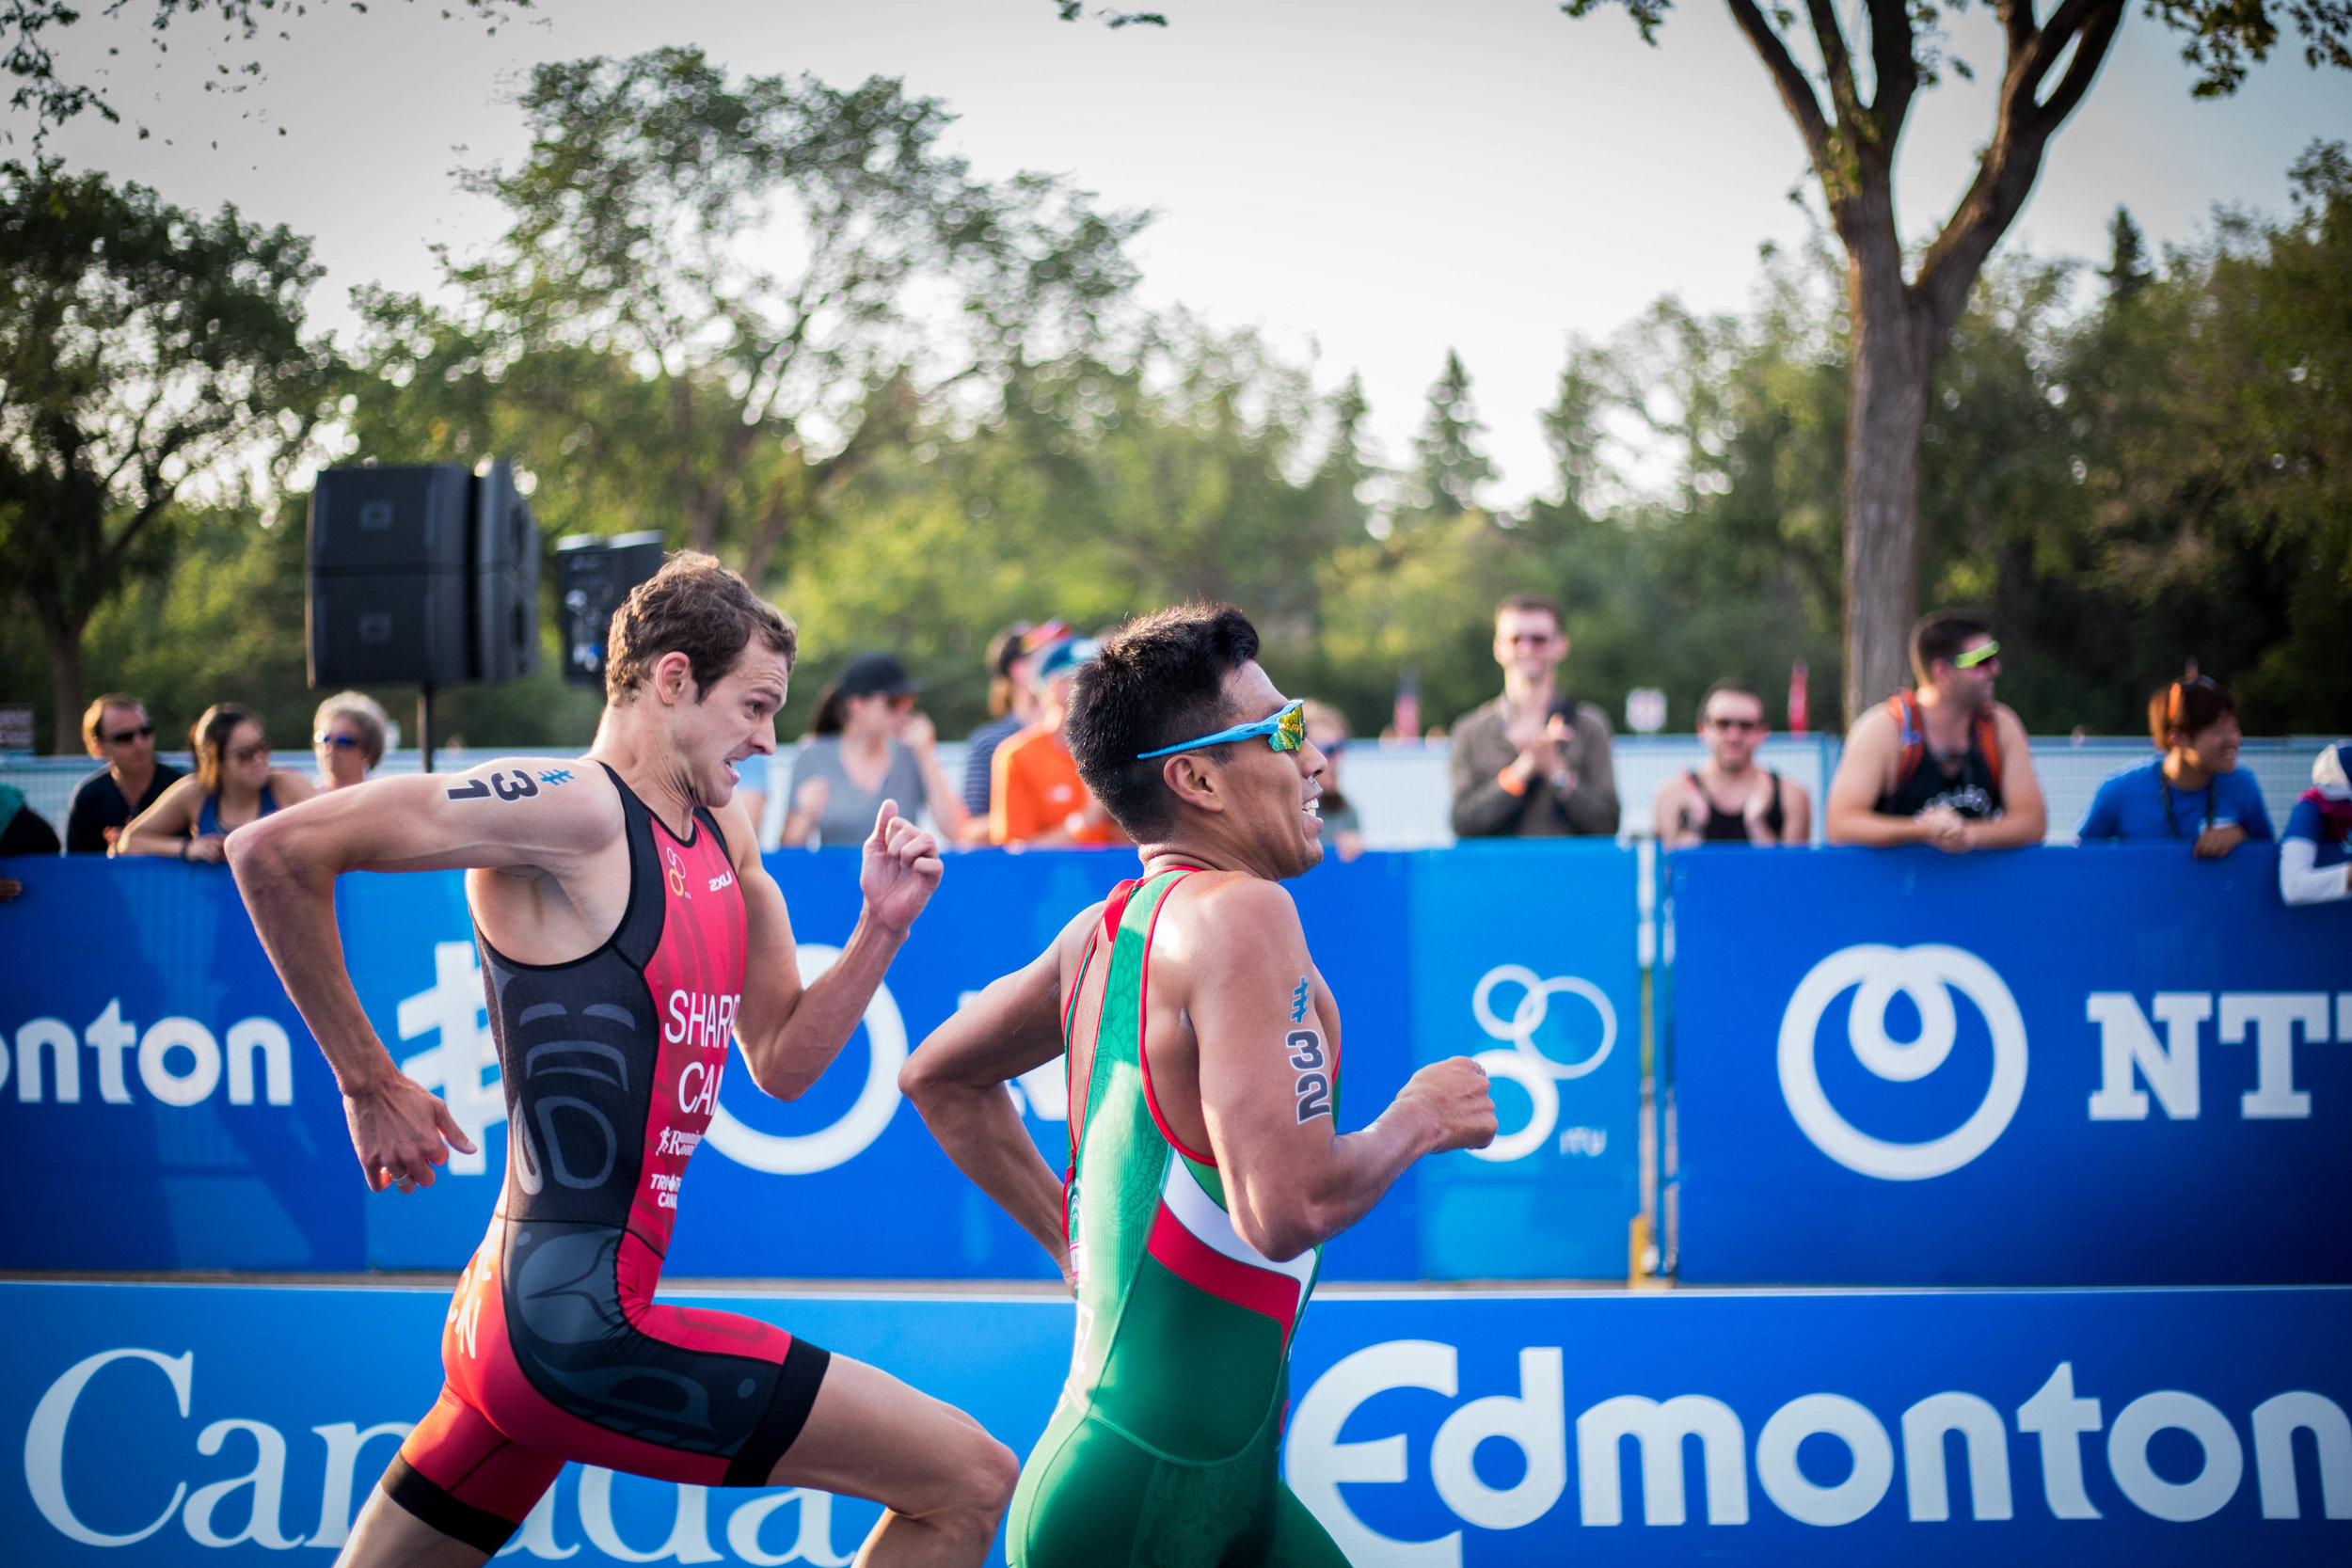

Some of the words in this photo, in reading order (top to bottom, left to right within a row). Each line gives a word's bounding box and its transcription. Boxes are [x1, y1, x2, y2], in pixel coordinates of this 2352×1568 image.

[446, 769, 539, 802] 31
[708, 870, 733, 892] 2XU
[0, 996, 294, 1107] nton
[1285, 1029, 1332, 1125] 32
[2086, 990, 2352, 1121] NT
[24, 1348, 858, 1567] Canda
[1284, 1338, 2352, 1568] Edmonton
